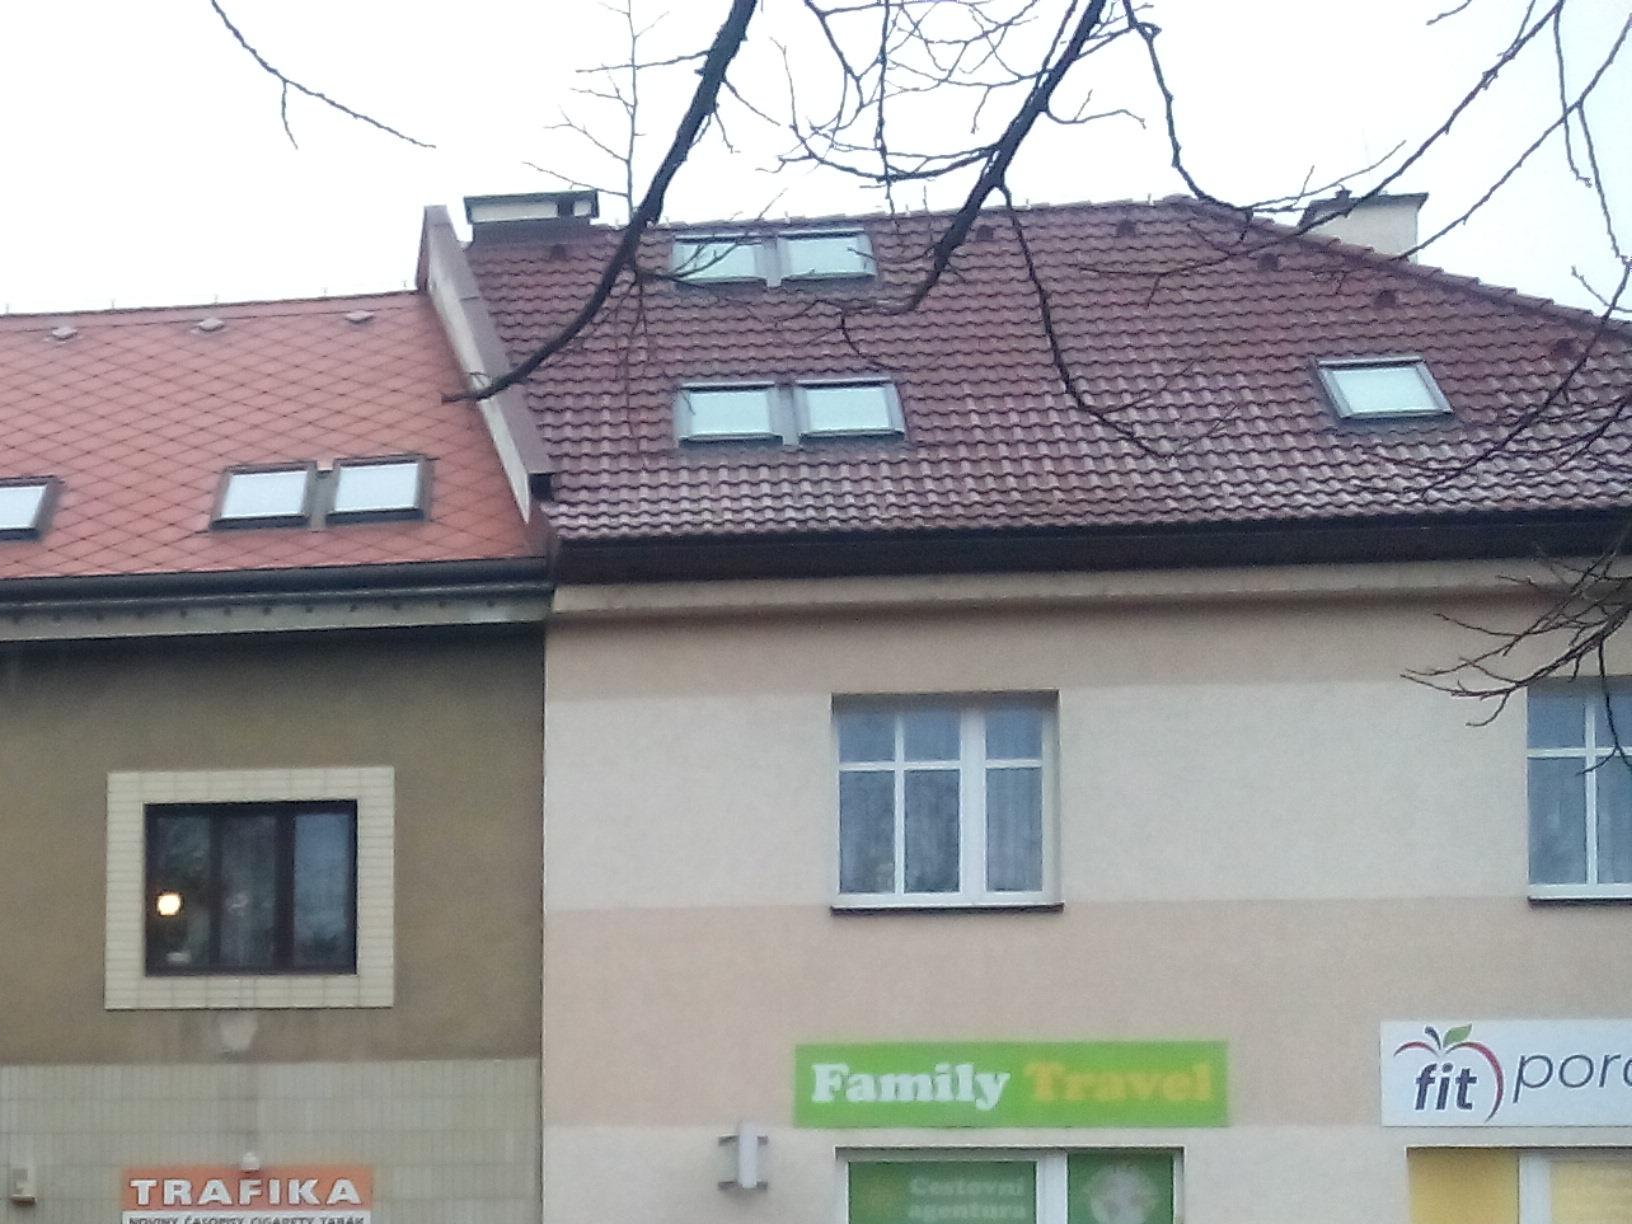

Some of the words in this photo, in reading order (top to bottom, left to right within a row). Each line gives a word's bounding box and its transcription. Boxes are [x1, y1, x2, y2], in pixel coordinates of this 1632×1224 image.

[810, 1062, 1011, 1112] Family
[1023, 1061, 1213, 1101] Travel
[1415, 1062, 1478, 1111] fit
[129, 1178, 363, 1206] TRAFIKA
